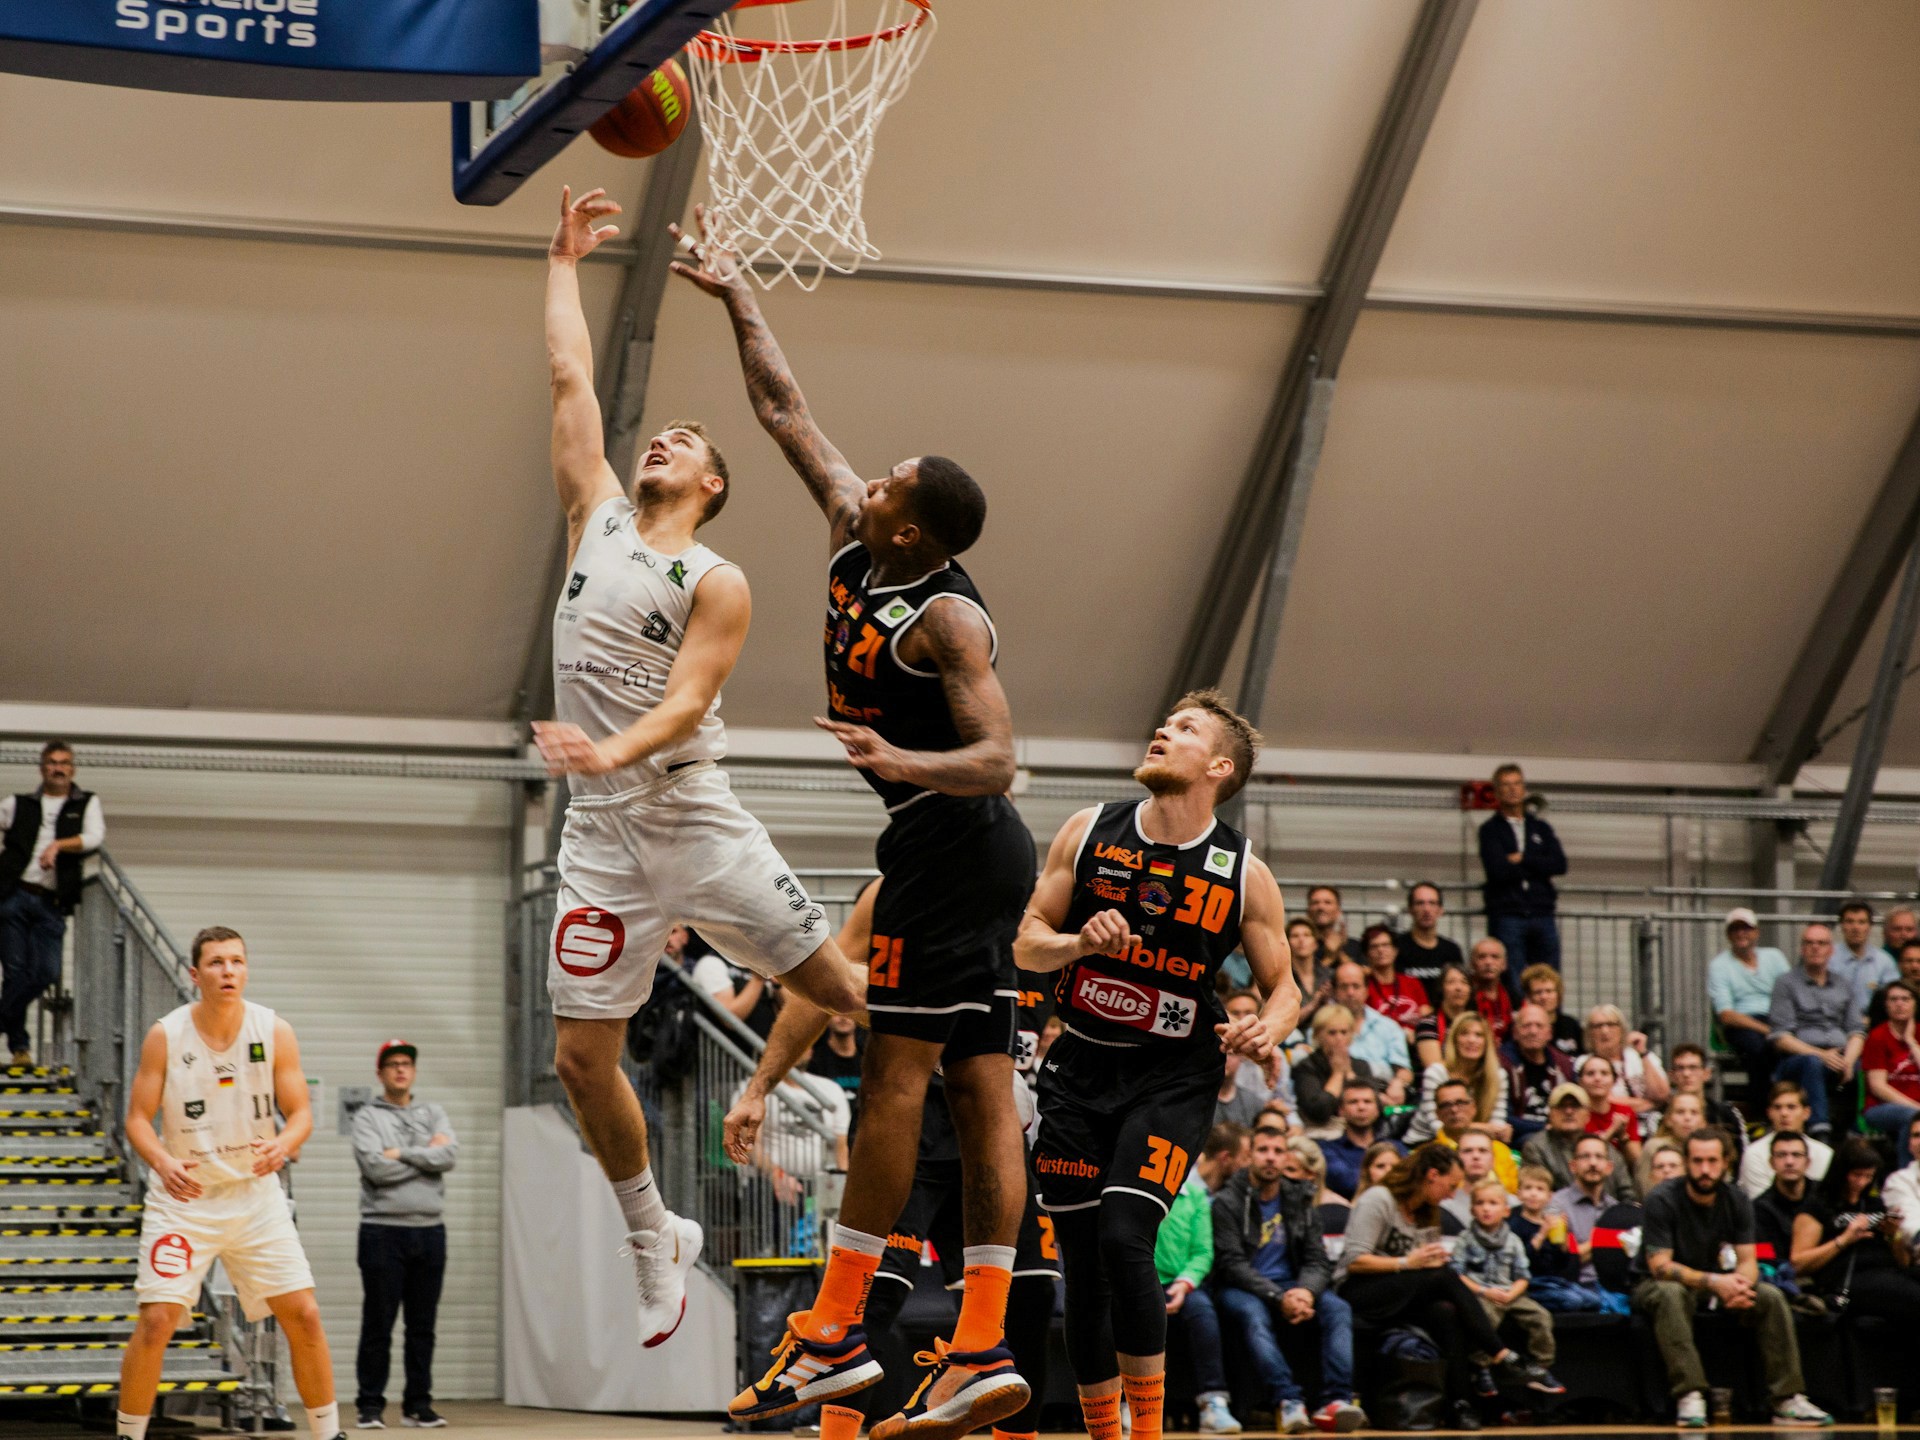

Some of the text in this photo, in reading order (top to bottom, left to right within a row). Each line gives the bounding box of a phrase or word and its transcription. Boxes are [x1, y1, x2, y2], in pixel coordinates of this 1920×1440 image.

[115, 0, 318, 47] Sports
[575, 661, 582, 672] &
[586, 661, 620, 674] Bauen
[847, 622, 886, 679] 21
[774, 874, 806, 911] 3
[1097, 866, 1132, 880] SPALDING
[1174, 875, 1235, 934] 30
[869, 934, 904, 988] 21
[1079, 980, 1152, 1016] Helios
[253, 1093, 272, 1119] 11
[1139, 1135, 1188, 1196] 30
